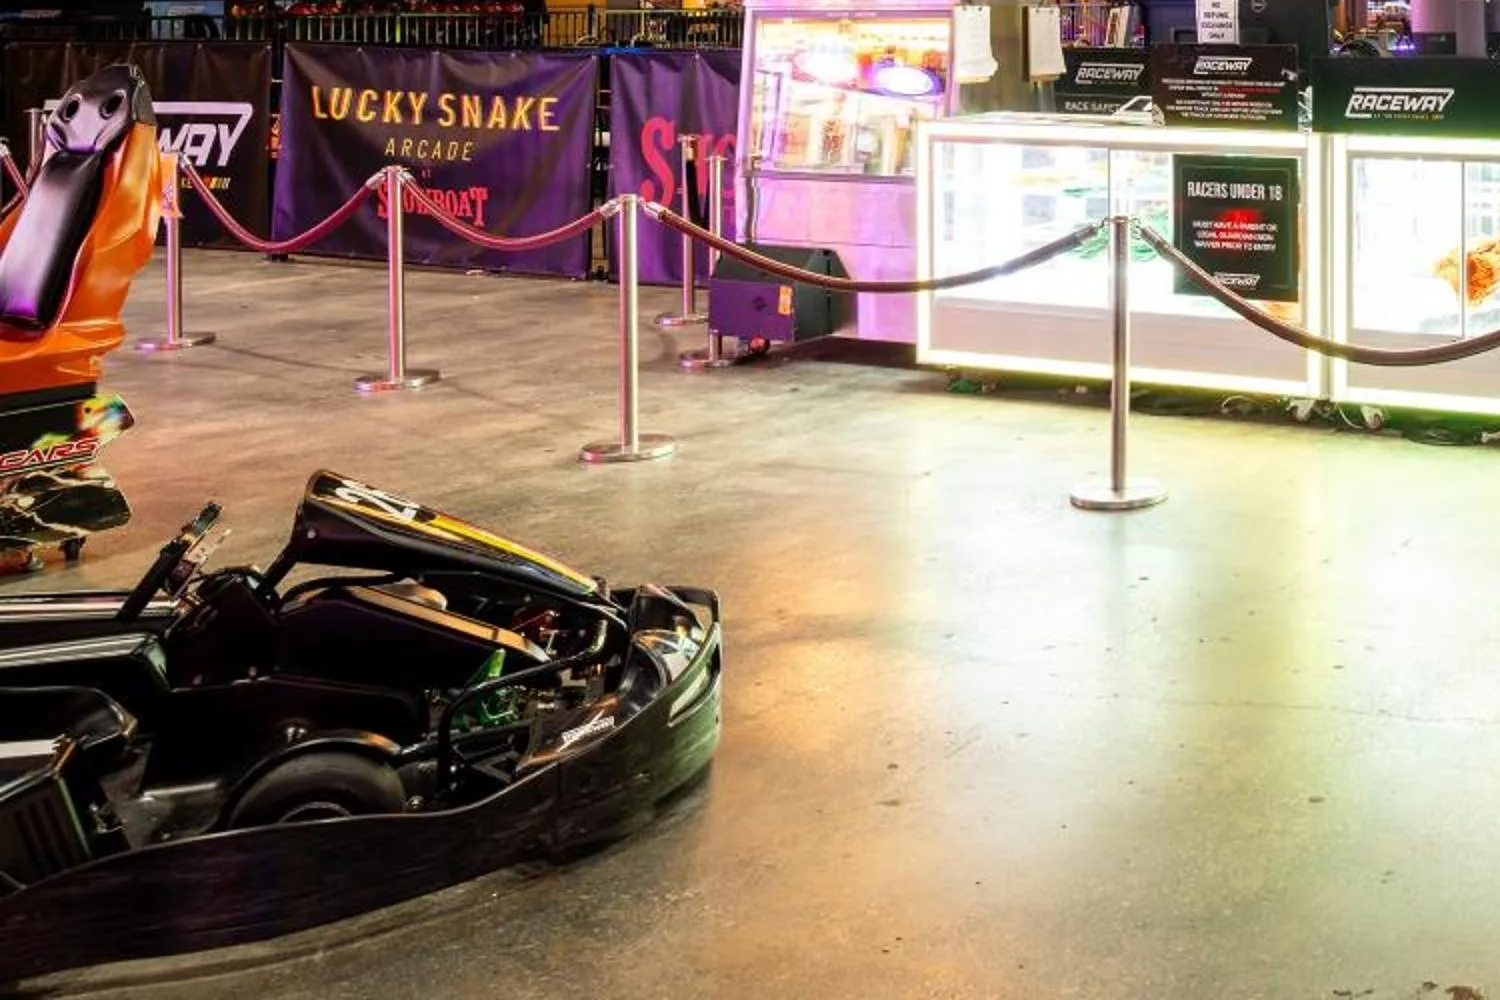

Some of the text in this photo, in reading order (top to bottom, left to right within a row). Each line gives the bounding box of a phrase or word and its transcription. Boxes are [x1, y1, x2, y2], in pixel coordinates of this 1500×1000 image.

[1077, 67, 1142, 81] RACEWAY
[1196, 61, 1250, 71] RACEWAY
[311, 86, 561, 131] LUCKY SNAKE
[1348, 93, 1452, 112] RACEWAY
[384, 137, 475, 162] ARCADE
[1187, 181, 1283, 201] RACERS UNDER 18
